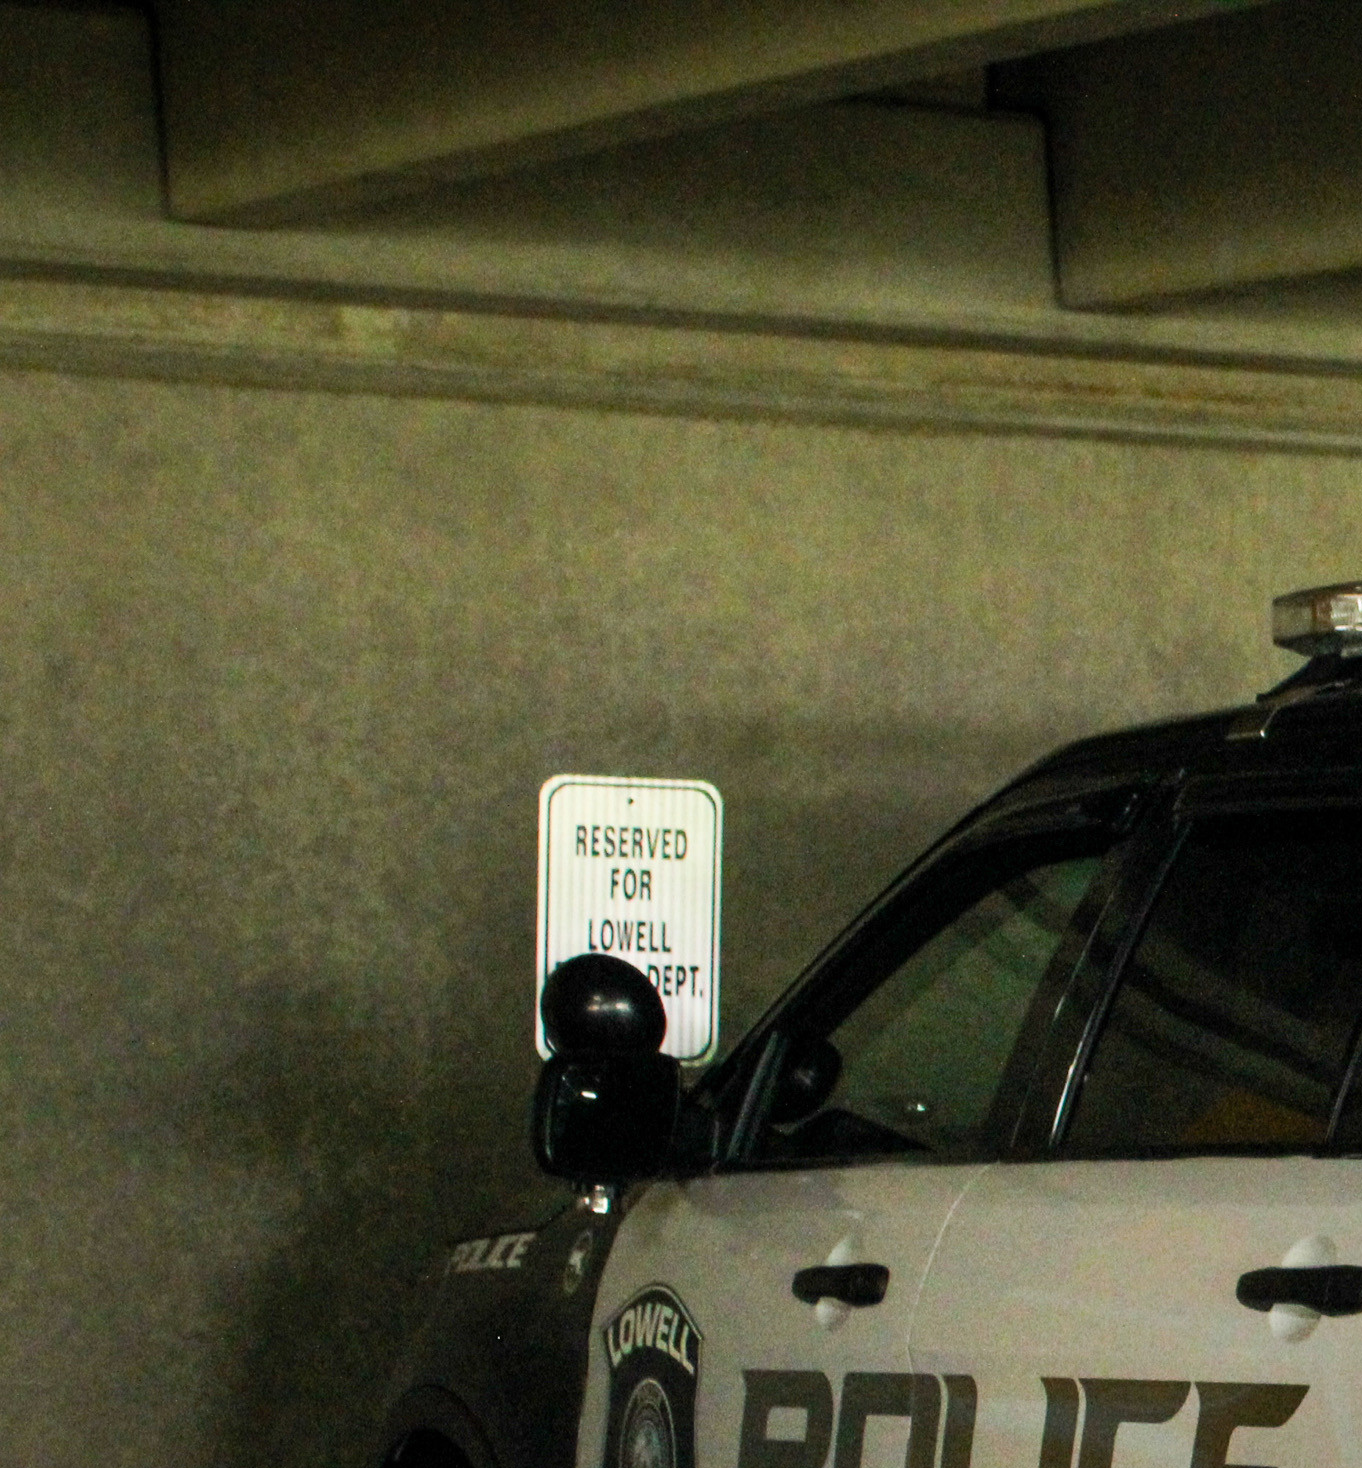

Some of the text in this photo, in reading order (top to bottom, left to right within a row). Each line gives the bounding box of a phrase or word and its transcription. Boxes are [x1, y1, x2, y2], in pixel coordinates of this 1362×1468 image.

[575, 825, 688, 860] RESERVED
[610, 868, 652, 901] FOR
[588, 919, 672, 953] LOWELL
[607, 1302, 695, 1375] LOWELL
